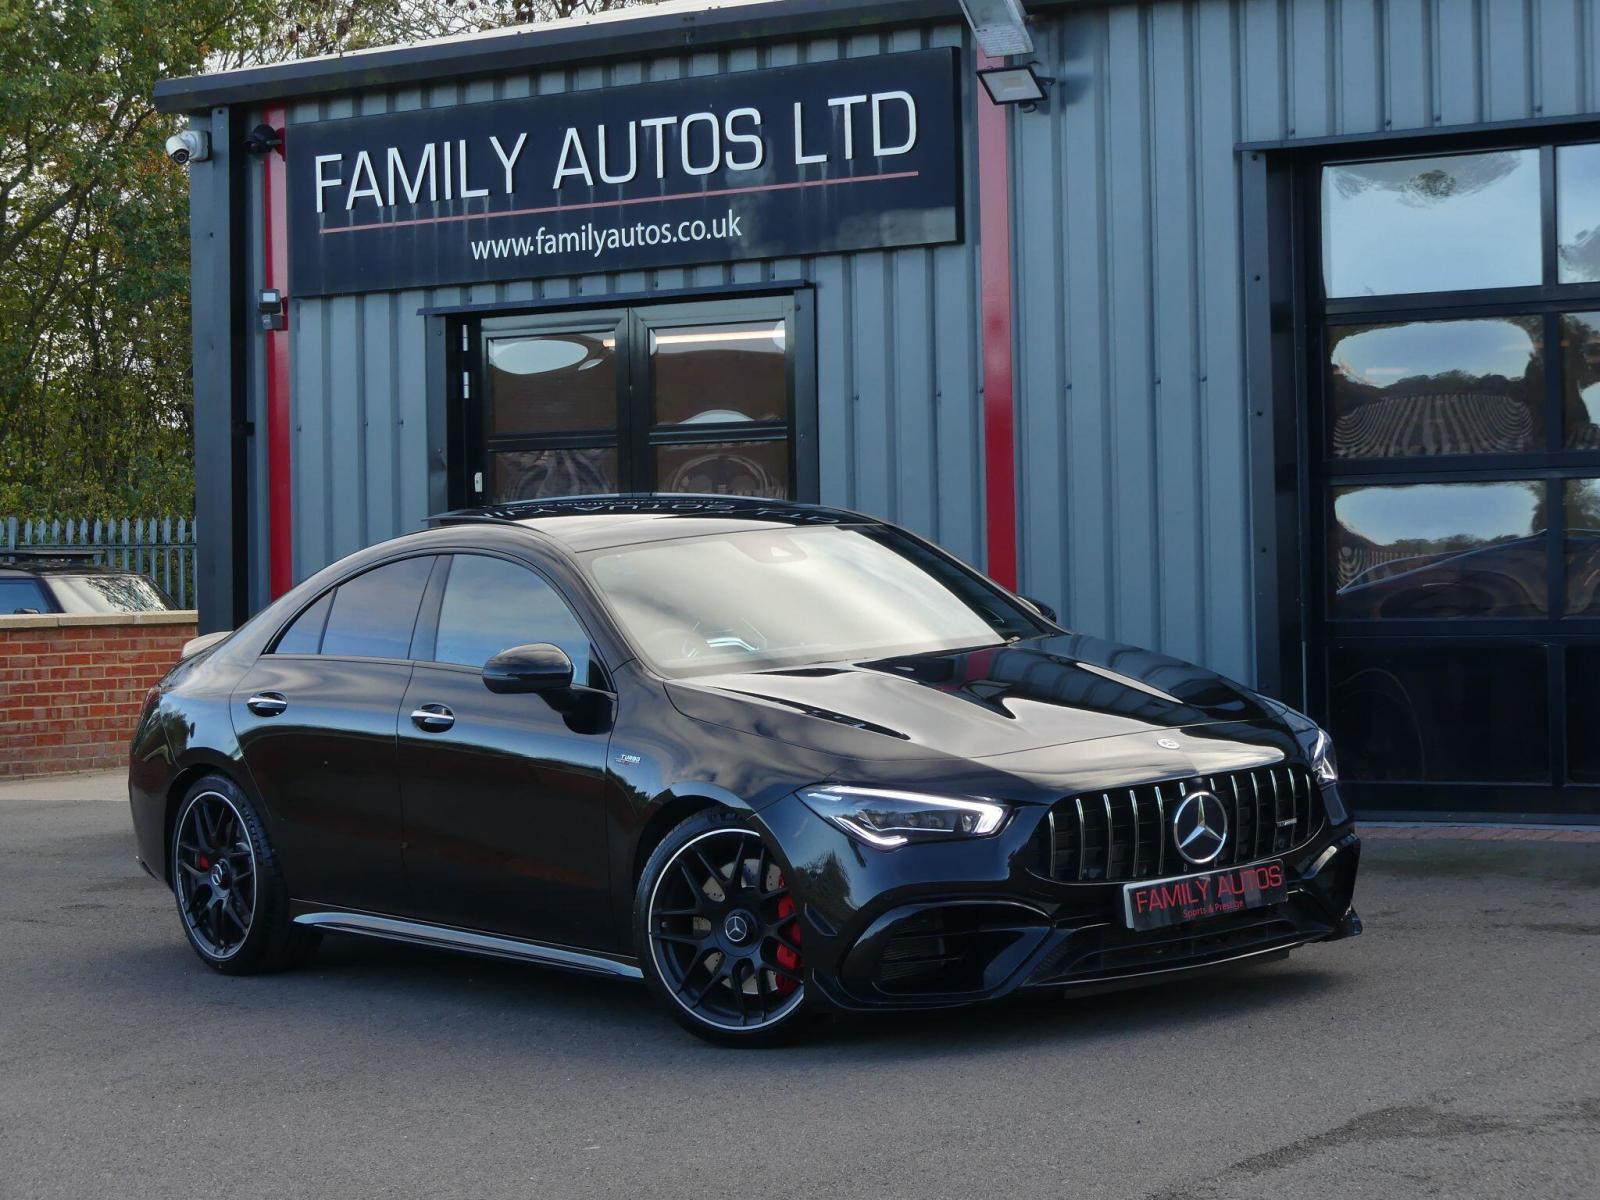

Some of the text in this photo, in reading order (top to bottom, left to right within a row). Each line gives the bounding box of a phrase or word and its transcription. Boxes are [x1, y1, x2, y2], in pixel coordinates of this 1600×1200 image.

[315, 90, 917, 213] FAMILY AUTOS LTD
[471, 209, 742, 260] www.familyautos.co.uk
[1135, 865, 1282, 914] FAMILY AUTOS
[1183, 906, 1208, 920] Sports
[1215, 900, 1244, 913] Prestige
